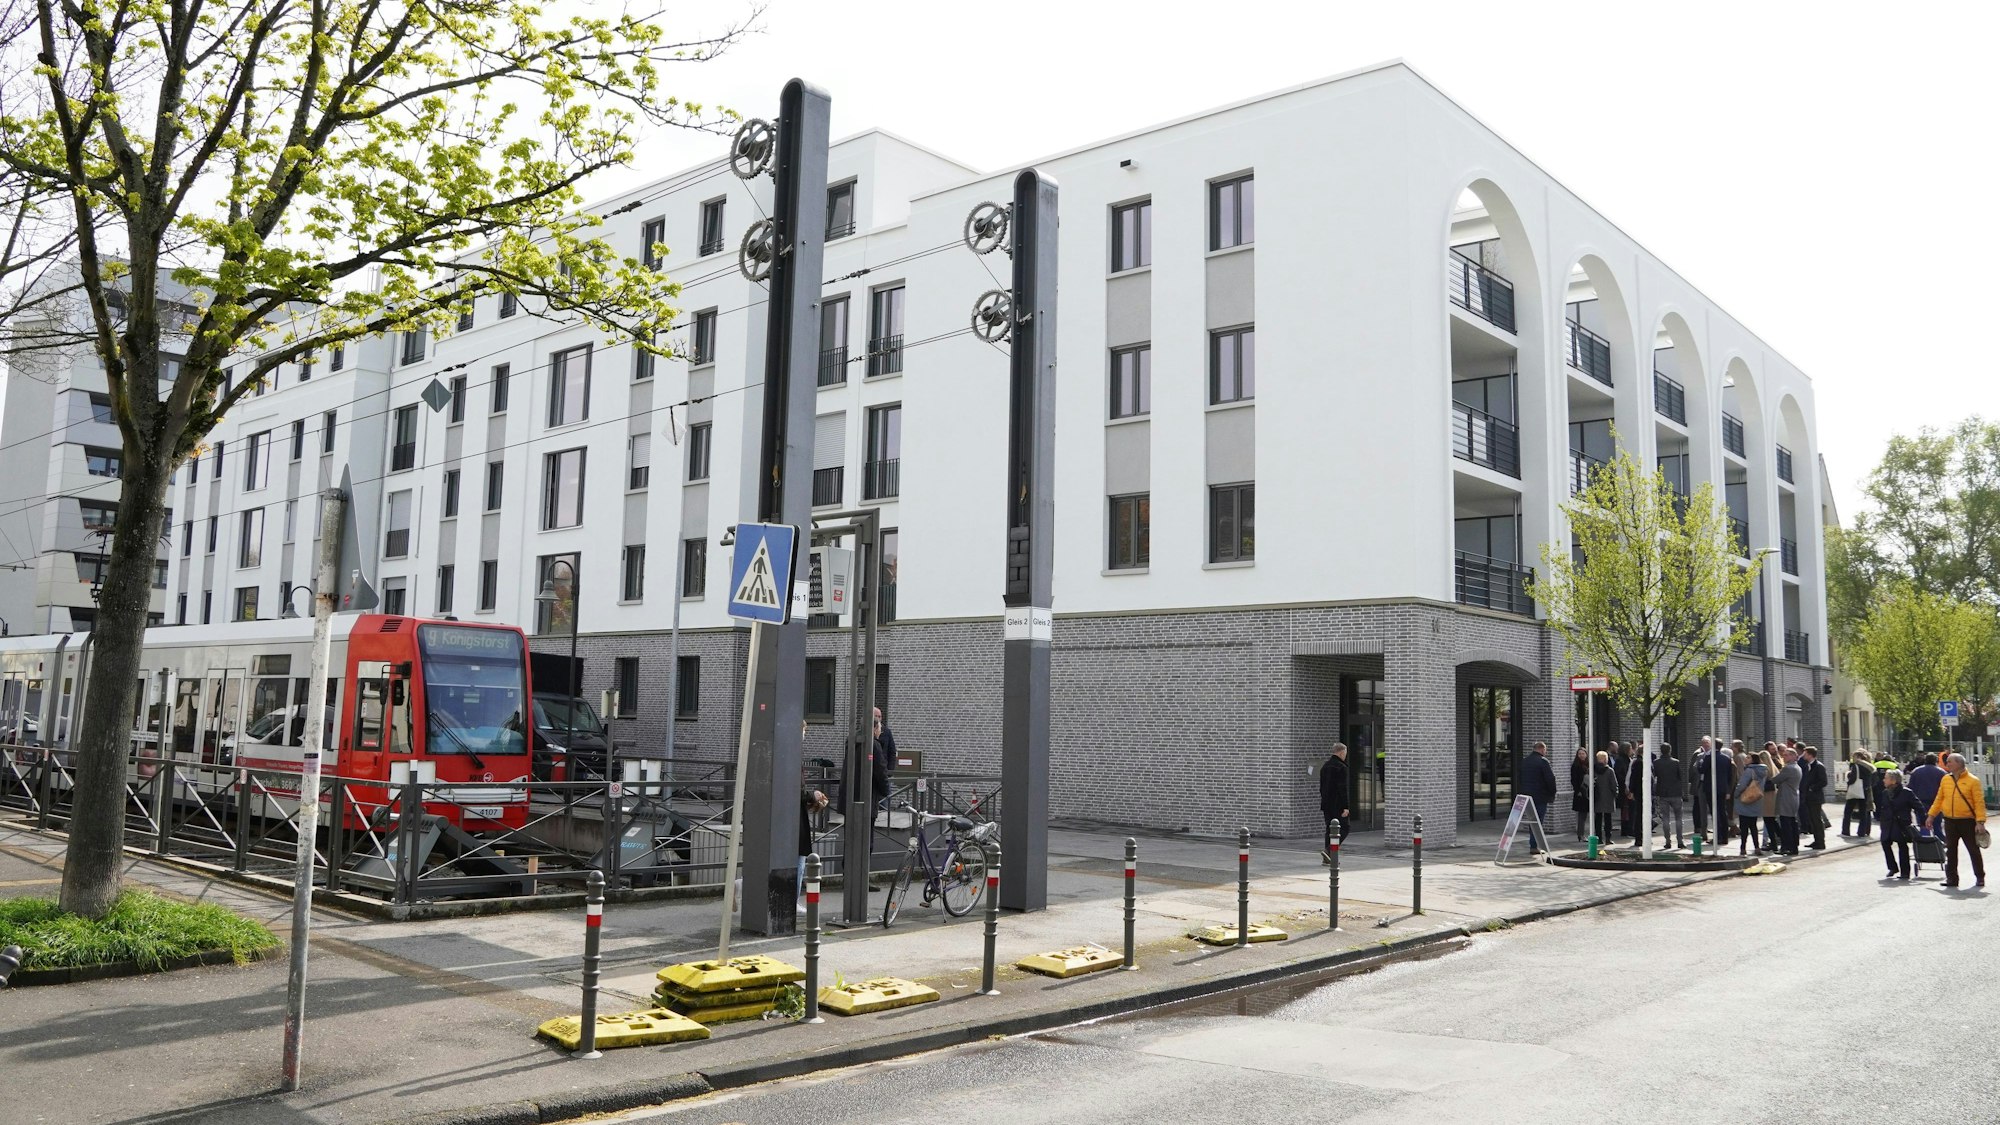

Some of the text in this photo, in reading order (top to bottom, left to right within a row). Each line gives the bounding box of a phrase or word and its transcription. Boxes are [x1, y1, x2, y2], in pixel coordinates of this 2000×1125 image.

[803, 594, 806, 602] 1
[1007, 618, 1022, 626] Gleis
[1032, 617, 1051, 627] Gleis 2
[441, 631, 510, 649] Königsforst
[1943, 703, 1954, 716] P
